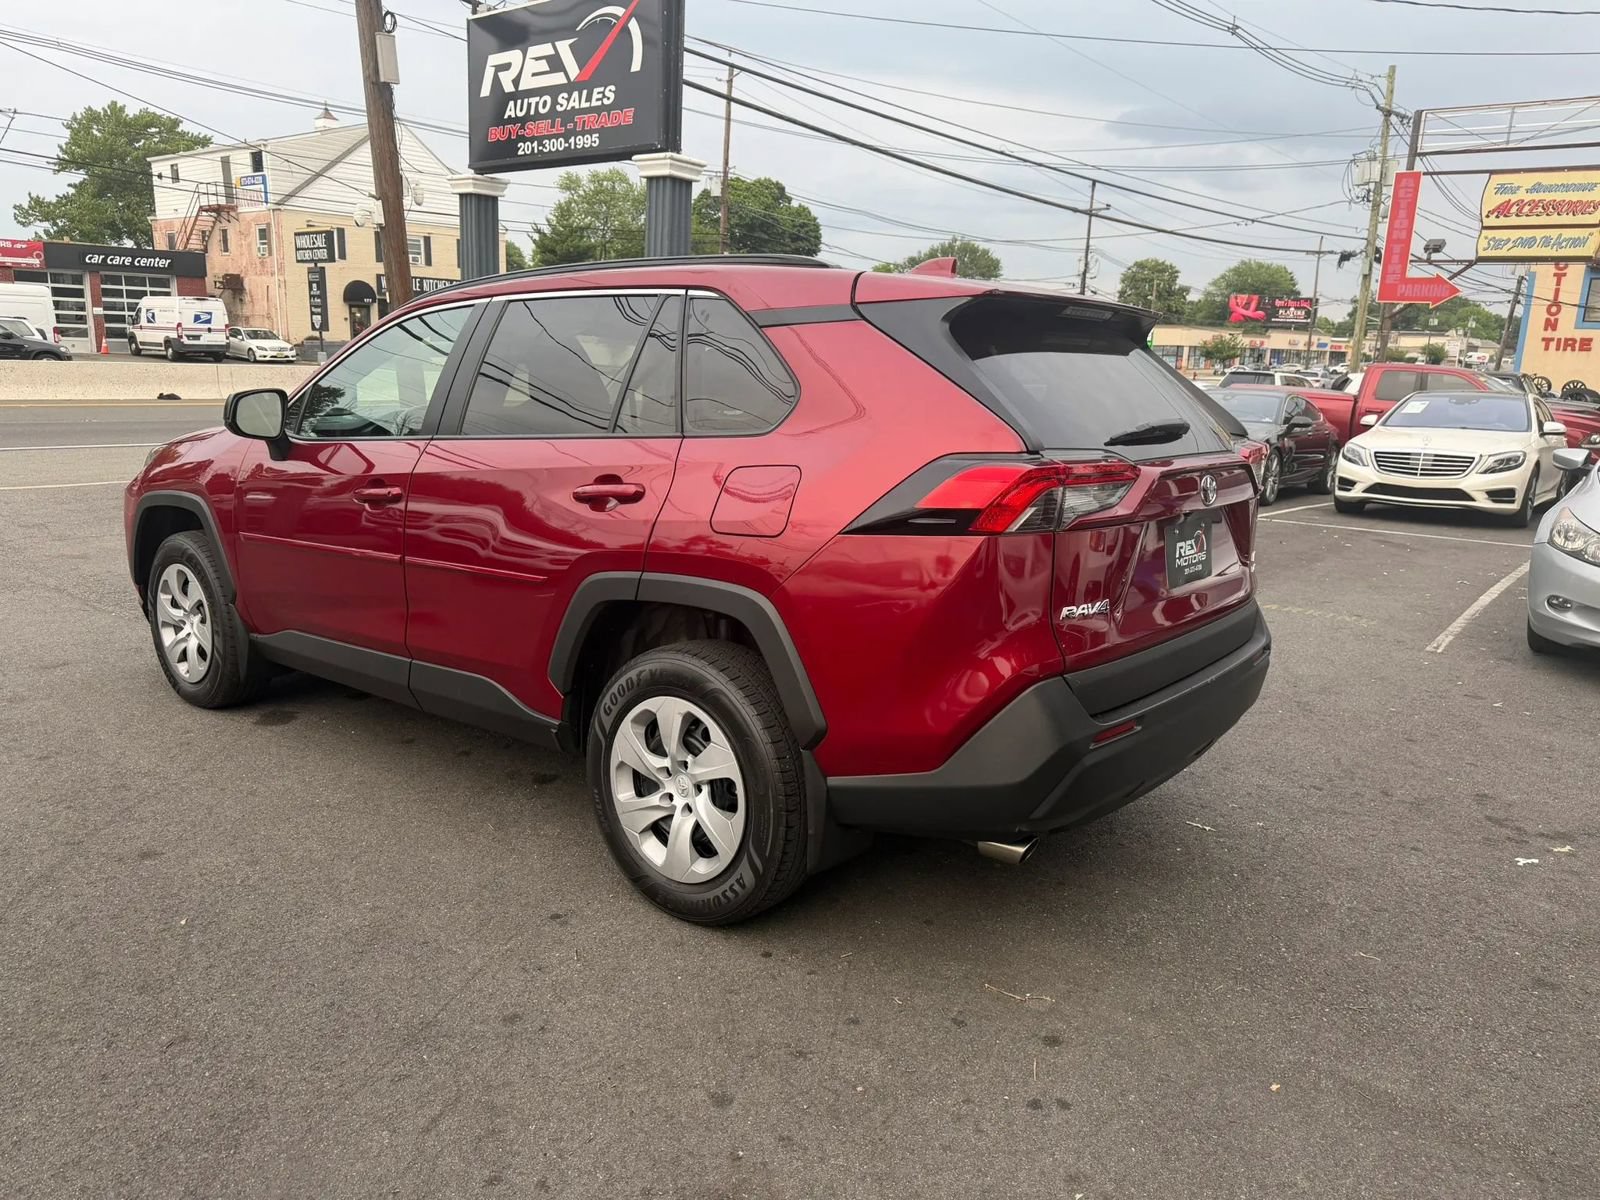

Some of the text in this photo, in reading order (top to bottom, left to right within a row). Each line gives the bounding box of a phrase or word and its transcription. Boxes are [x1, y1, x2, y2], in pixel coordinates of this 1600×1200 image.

[503, 85, 616, 119] AUTO SALES
[517, 134, 600, 156] 201-300-1995
[1485, 198, 1600, 219] ACCESSORIES
[295, 233, 327, 249] WHOLESALE
[85, 253, 171, 268] car care center
[296, 249, 328, 260] KITCHEN CENTER
[1397, 284, 1450, 298] PARKING
[1541, 337, 1593, 352] TIRE
[1175, 552, 1207, 568] MOTORS
[1060, 599, 1109, 620] RAV4
